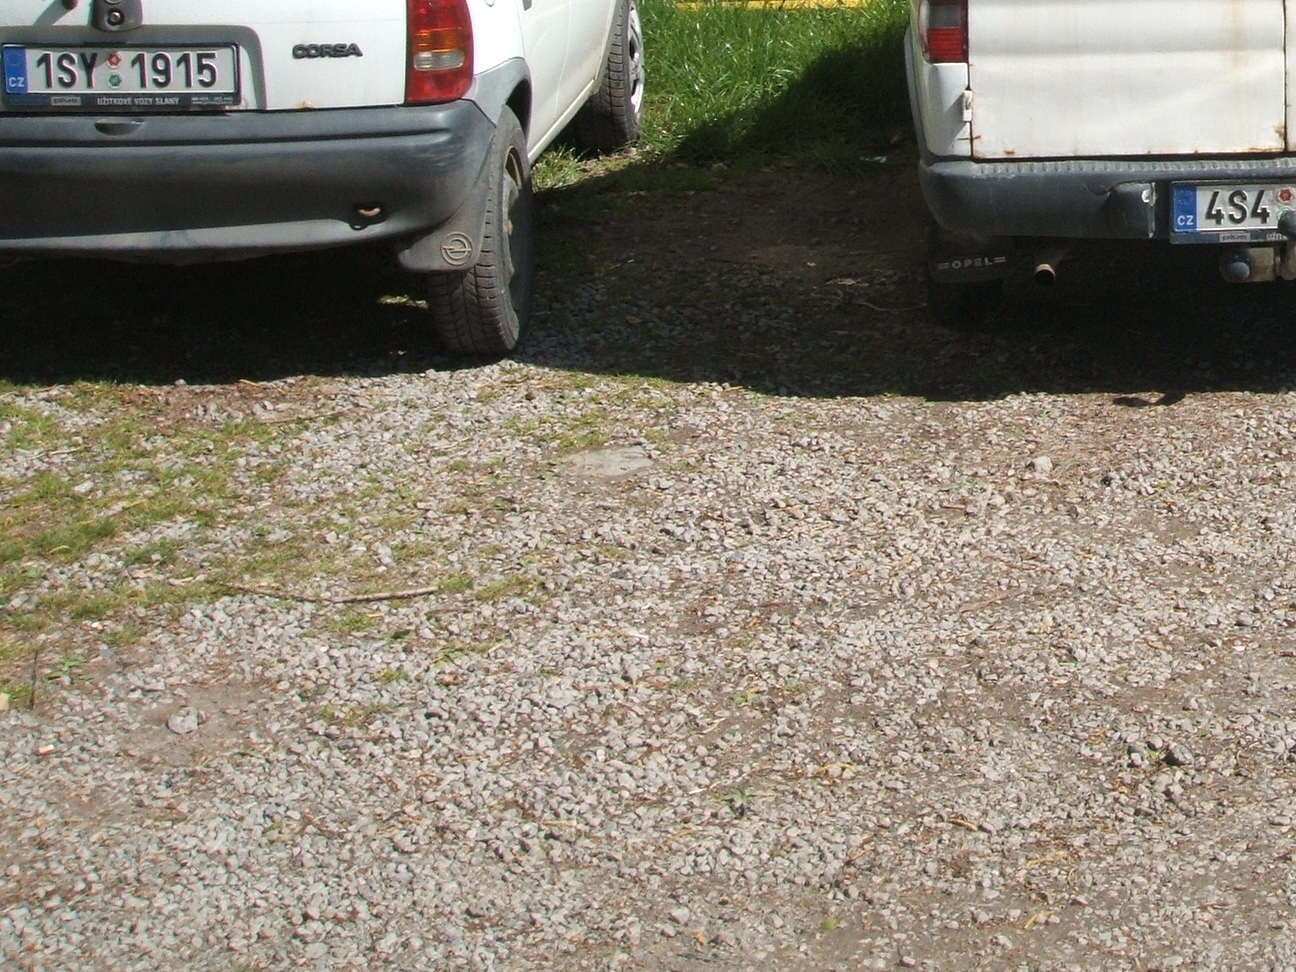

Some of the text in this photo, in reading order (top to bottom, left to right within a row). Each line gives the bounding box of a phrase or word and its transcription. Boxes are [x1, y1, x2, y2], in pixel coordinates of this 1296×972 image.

[292, 43, 363, 59] CORSA
[9, 51, 218, 89] CZ 1SY 1915
[1177, 215, 1194, 226] CZ
[1205, 189, 1270, 225] 4S4
[951, 257, 993, 268] OPEL
